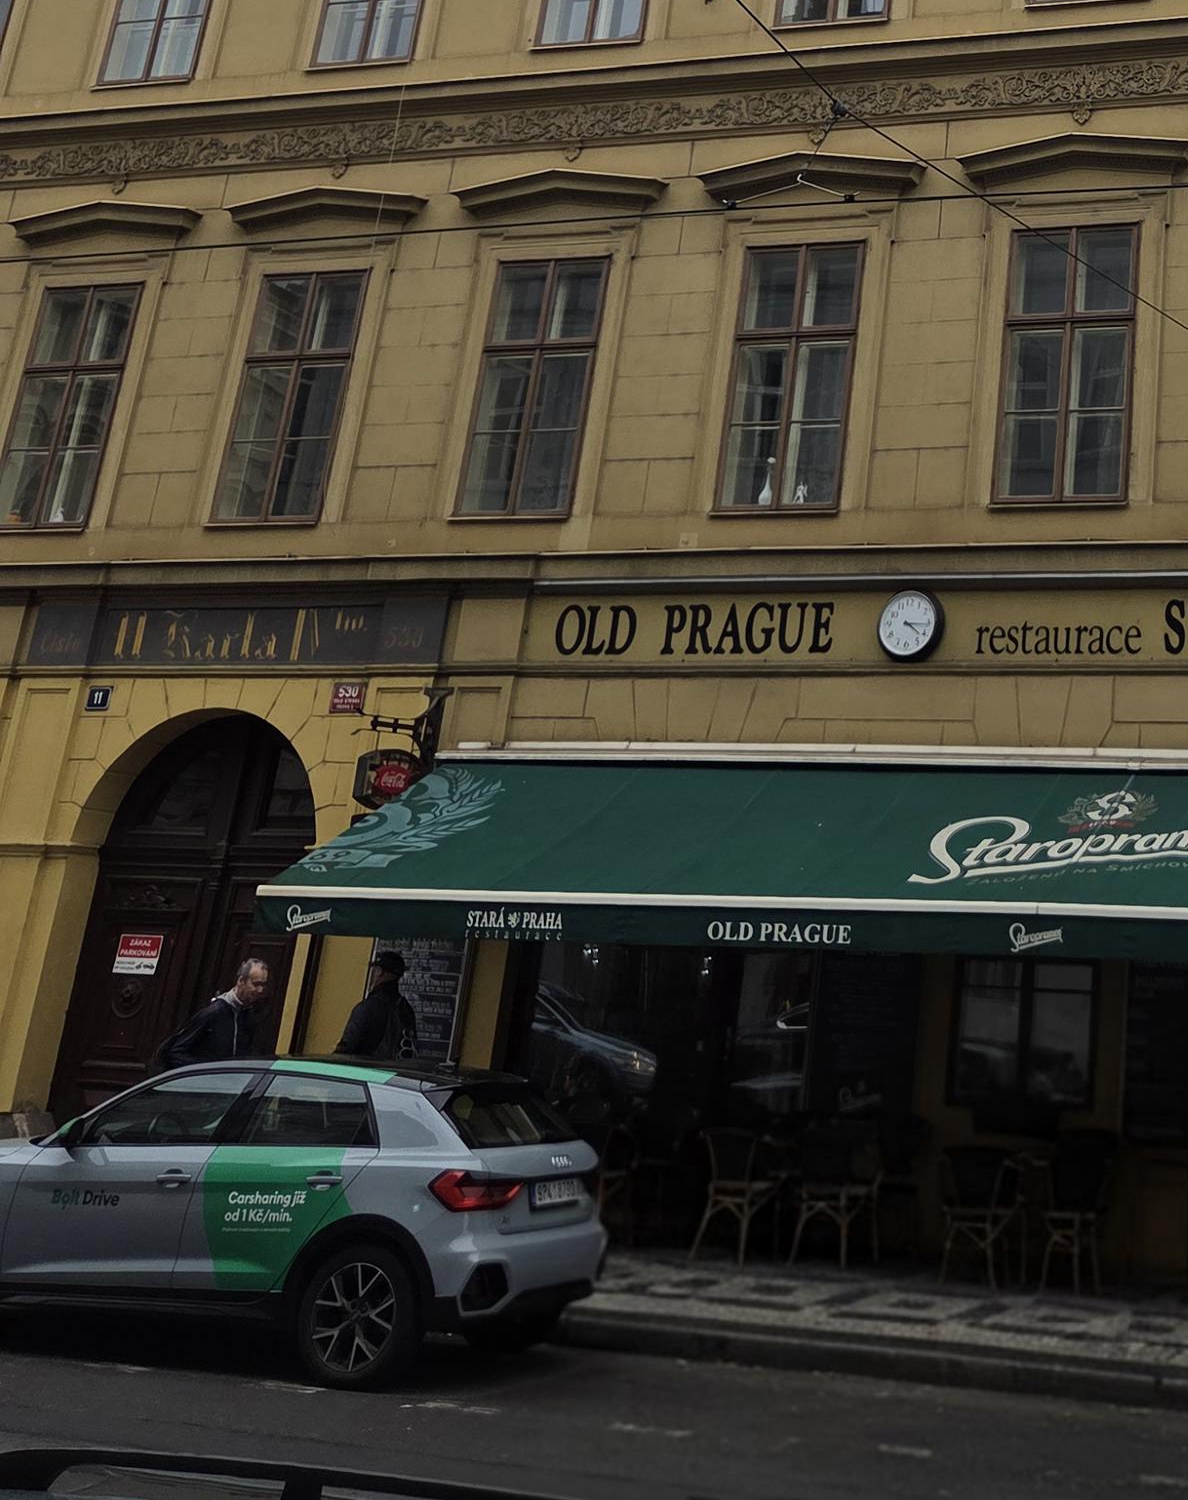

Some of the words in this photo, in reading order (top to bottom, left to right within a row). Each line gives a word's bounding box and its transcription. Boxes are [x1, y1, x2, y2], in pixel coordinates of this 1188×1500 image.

[555, 604, 637, 656] OLD
[660, 601, 834, 655] PRAGUE
[975, 620, 1143, 655] restaurace
[93, 691, 103, 704] 11
[338, 685, 359, 698] 530
[466, 907, 505, 929] STARÁ
[522, 910, 563, 930] PRAHA
[464, 929, 563, 941] restaurace
[707, 920, 754, 941] OLD
[758, 922, 852, 944] PRAGUE
[1009, 922, 1063, 952] Staropramen
[51, 1188, 80, 1211] Bolt
[82, 1189, 120, 1207] Drive
[228, 1190, 291, 1206] Carsharing
[291, 1190, 308, 1208] již
[224, 1208, 240, 1223] od
[248, 1208, 293, 1223] Kč/min.
